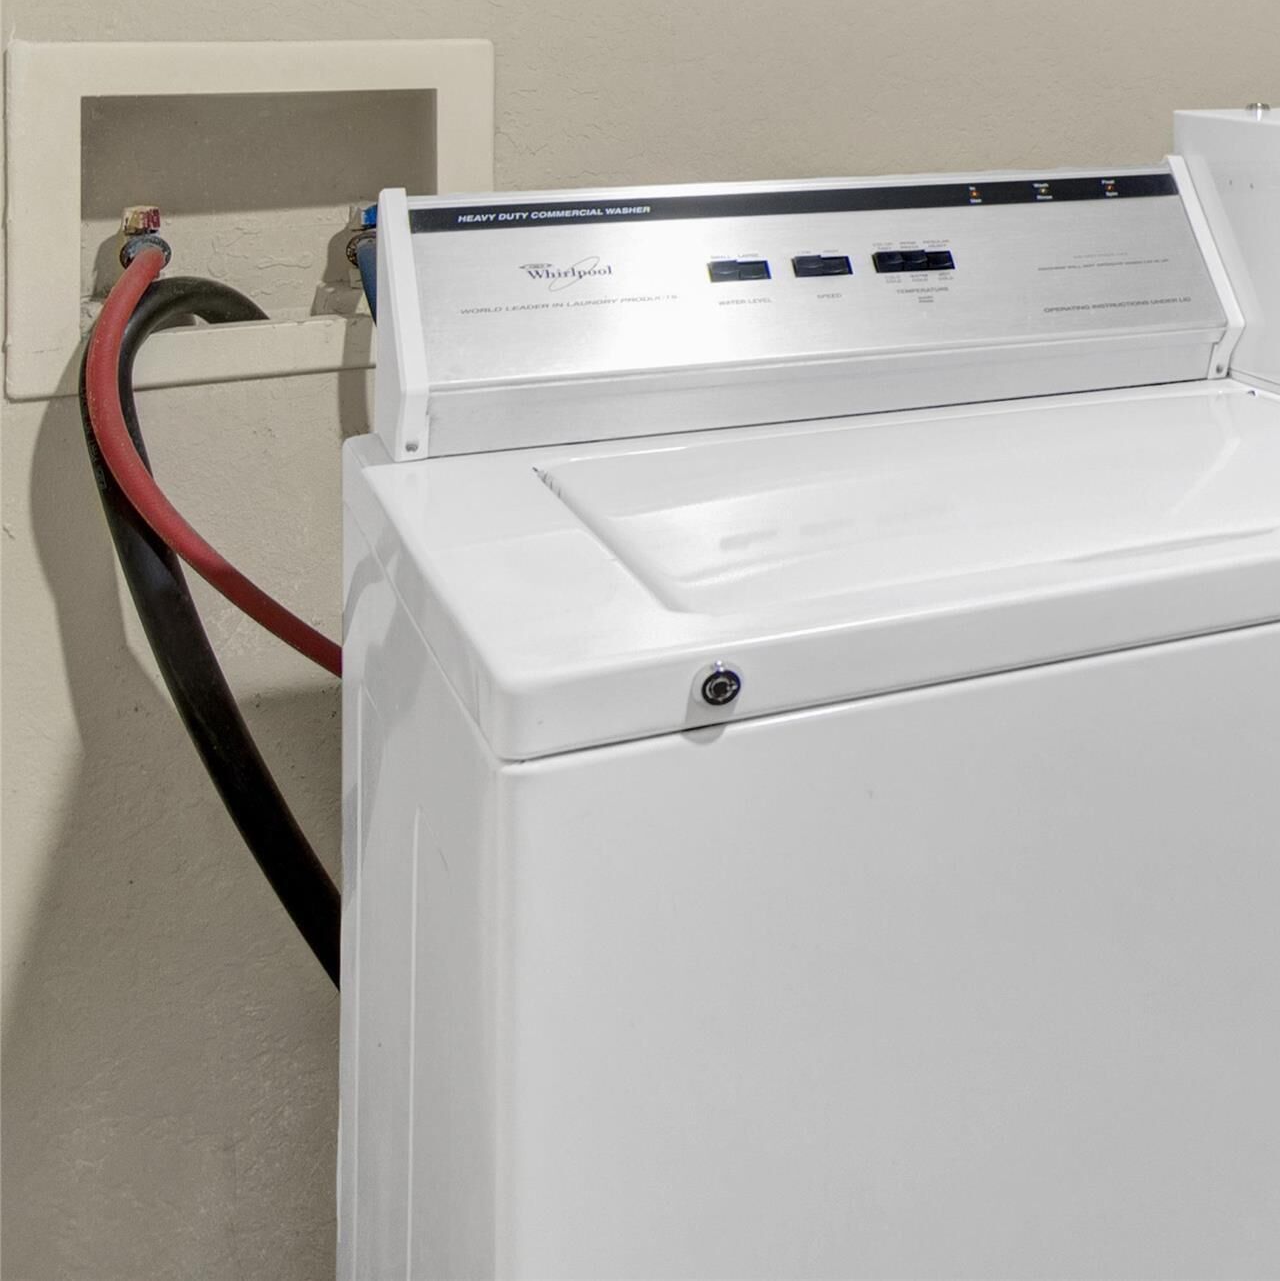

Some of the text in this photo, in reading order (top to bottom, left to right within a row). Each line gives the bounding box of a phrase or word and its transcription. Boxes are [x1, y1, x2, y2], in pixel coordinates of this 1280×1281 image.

[458, 205, 651, 223] HEAVY DUTY COMMERCIAL WASHER
[527, 264, 613, 280] Whirlpool
[460, 306, 502, 314] WORLD
[505, 303, 549, 311] LEADER
[566, 298, 619, 308] LAUNDRY
[1043, 303, 1091, 313] OPERATING
[1092, 299, 1150, 310] INSTRUCTIONS
